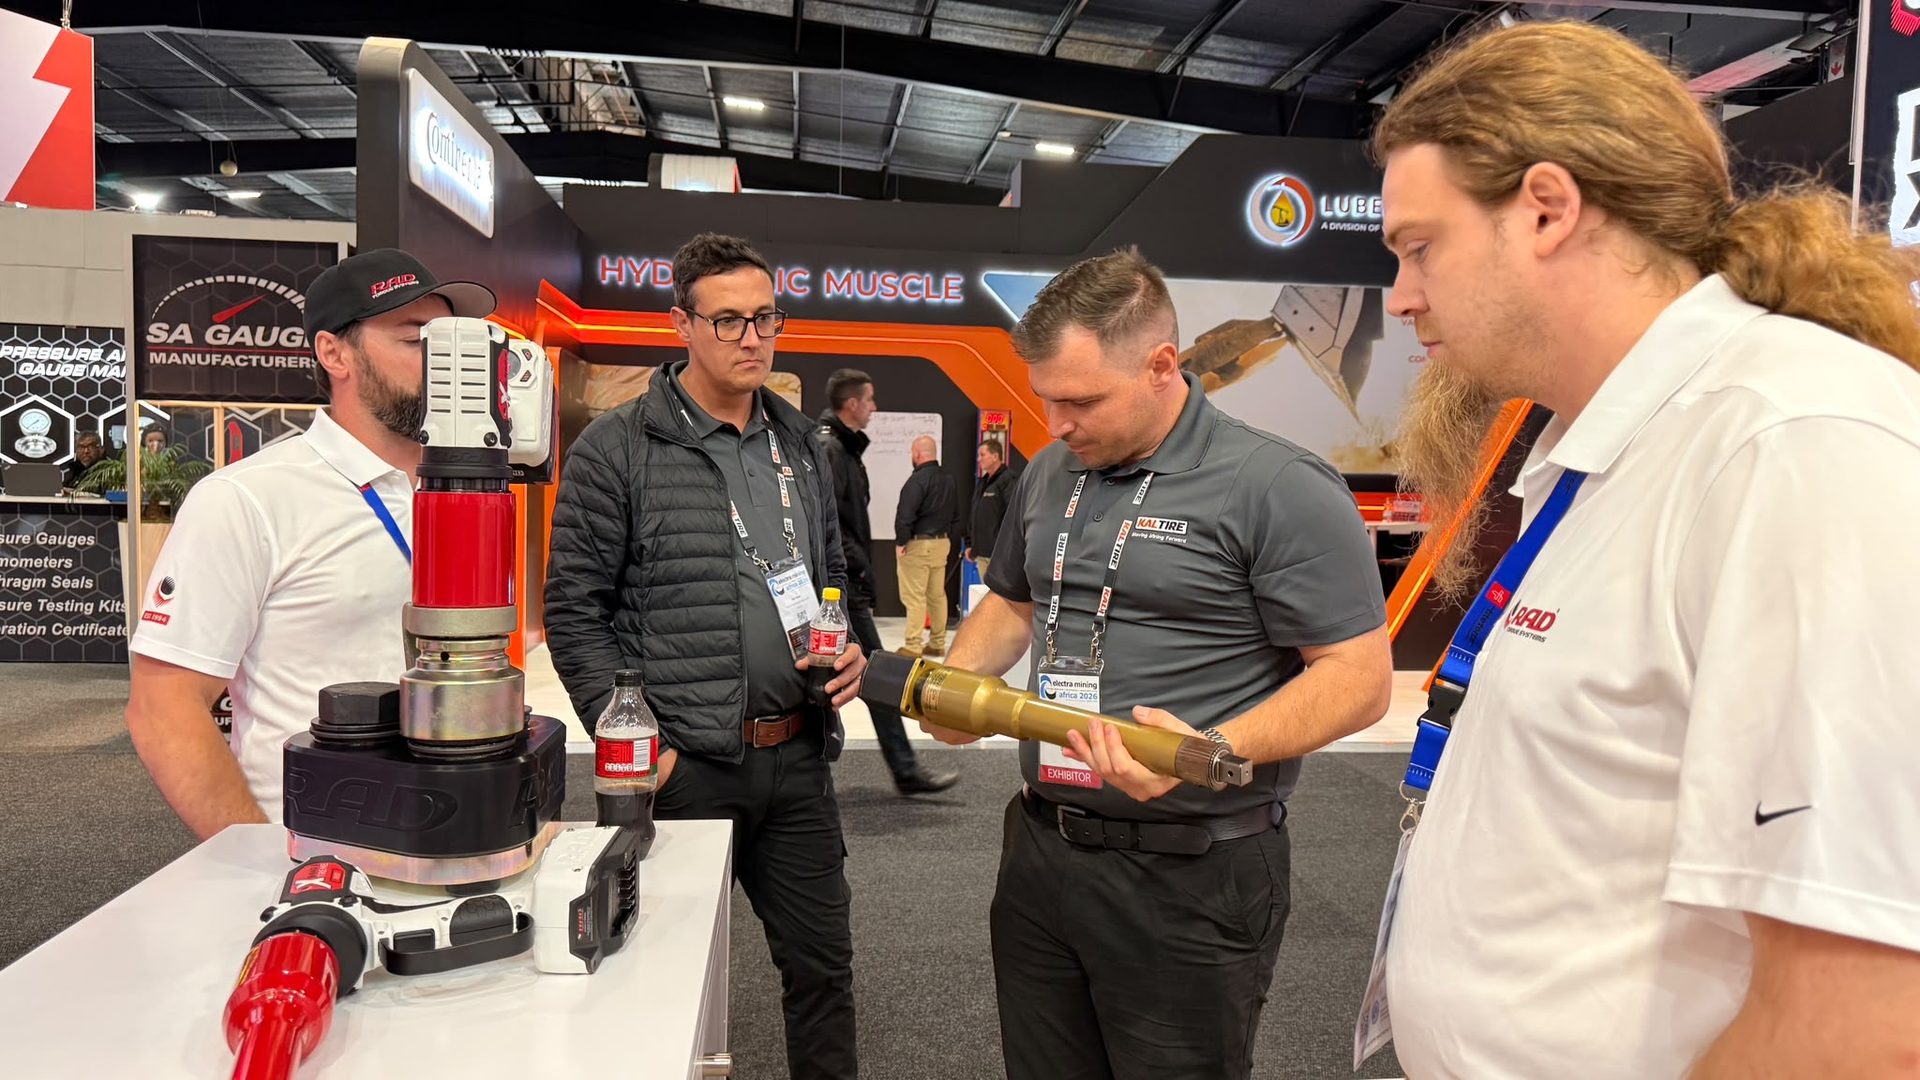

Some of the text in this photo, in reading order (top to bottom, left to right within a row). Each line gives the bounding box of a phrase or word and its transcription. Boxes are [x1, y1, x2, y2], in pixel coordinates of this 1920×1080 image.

[1321, 221, 1380, 232] A DIVISION OF
[600, 256, 964, 301] HYDIC MUSCLE
[146, 322, 310, 348] SA GAUG
[0, 346, 103, 361] PRESSURE
[19, 362, 87, 377] GAUGE
[0, 532, 95, 548] sure Gauges
[51, 576, 94, 589] Seals
[37, 599, 97, 614] Testing
[98, 601, 126, 613] Kits
[1052, 680, 1073, 688] electra
[1074, 680, 1098, 690] mining
[1059, 691, 1098, 700] africa 2026
[1047, 768, 1092, 783] EXHIBITOR
